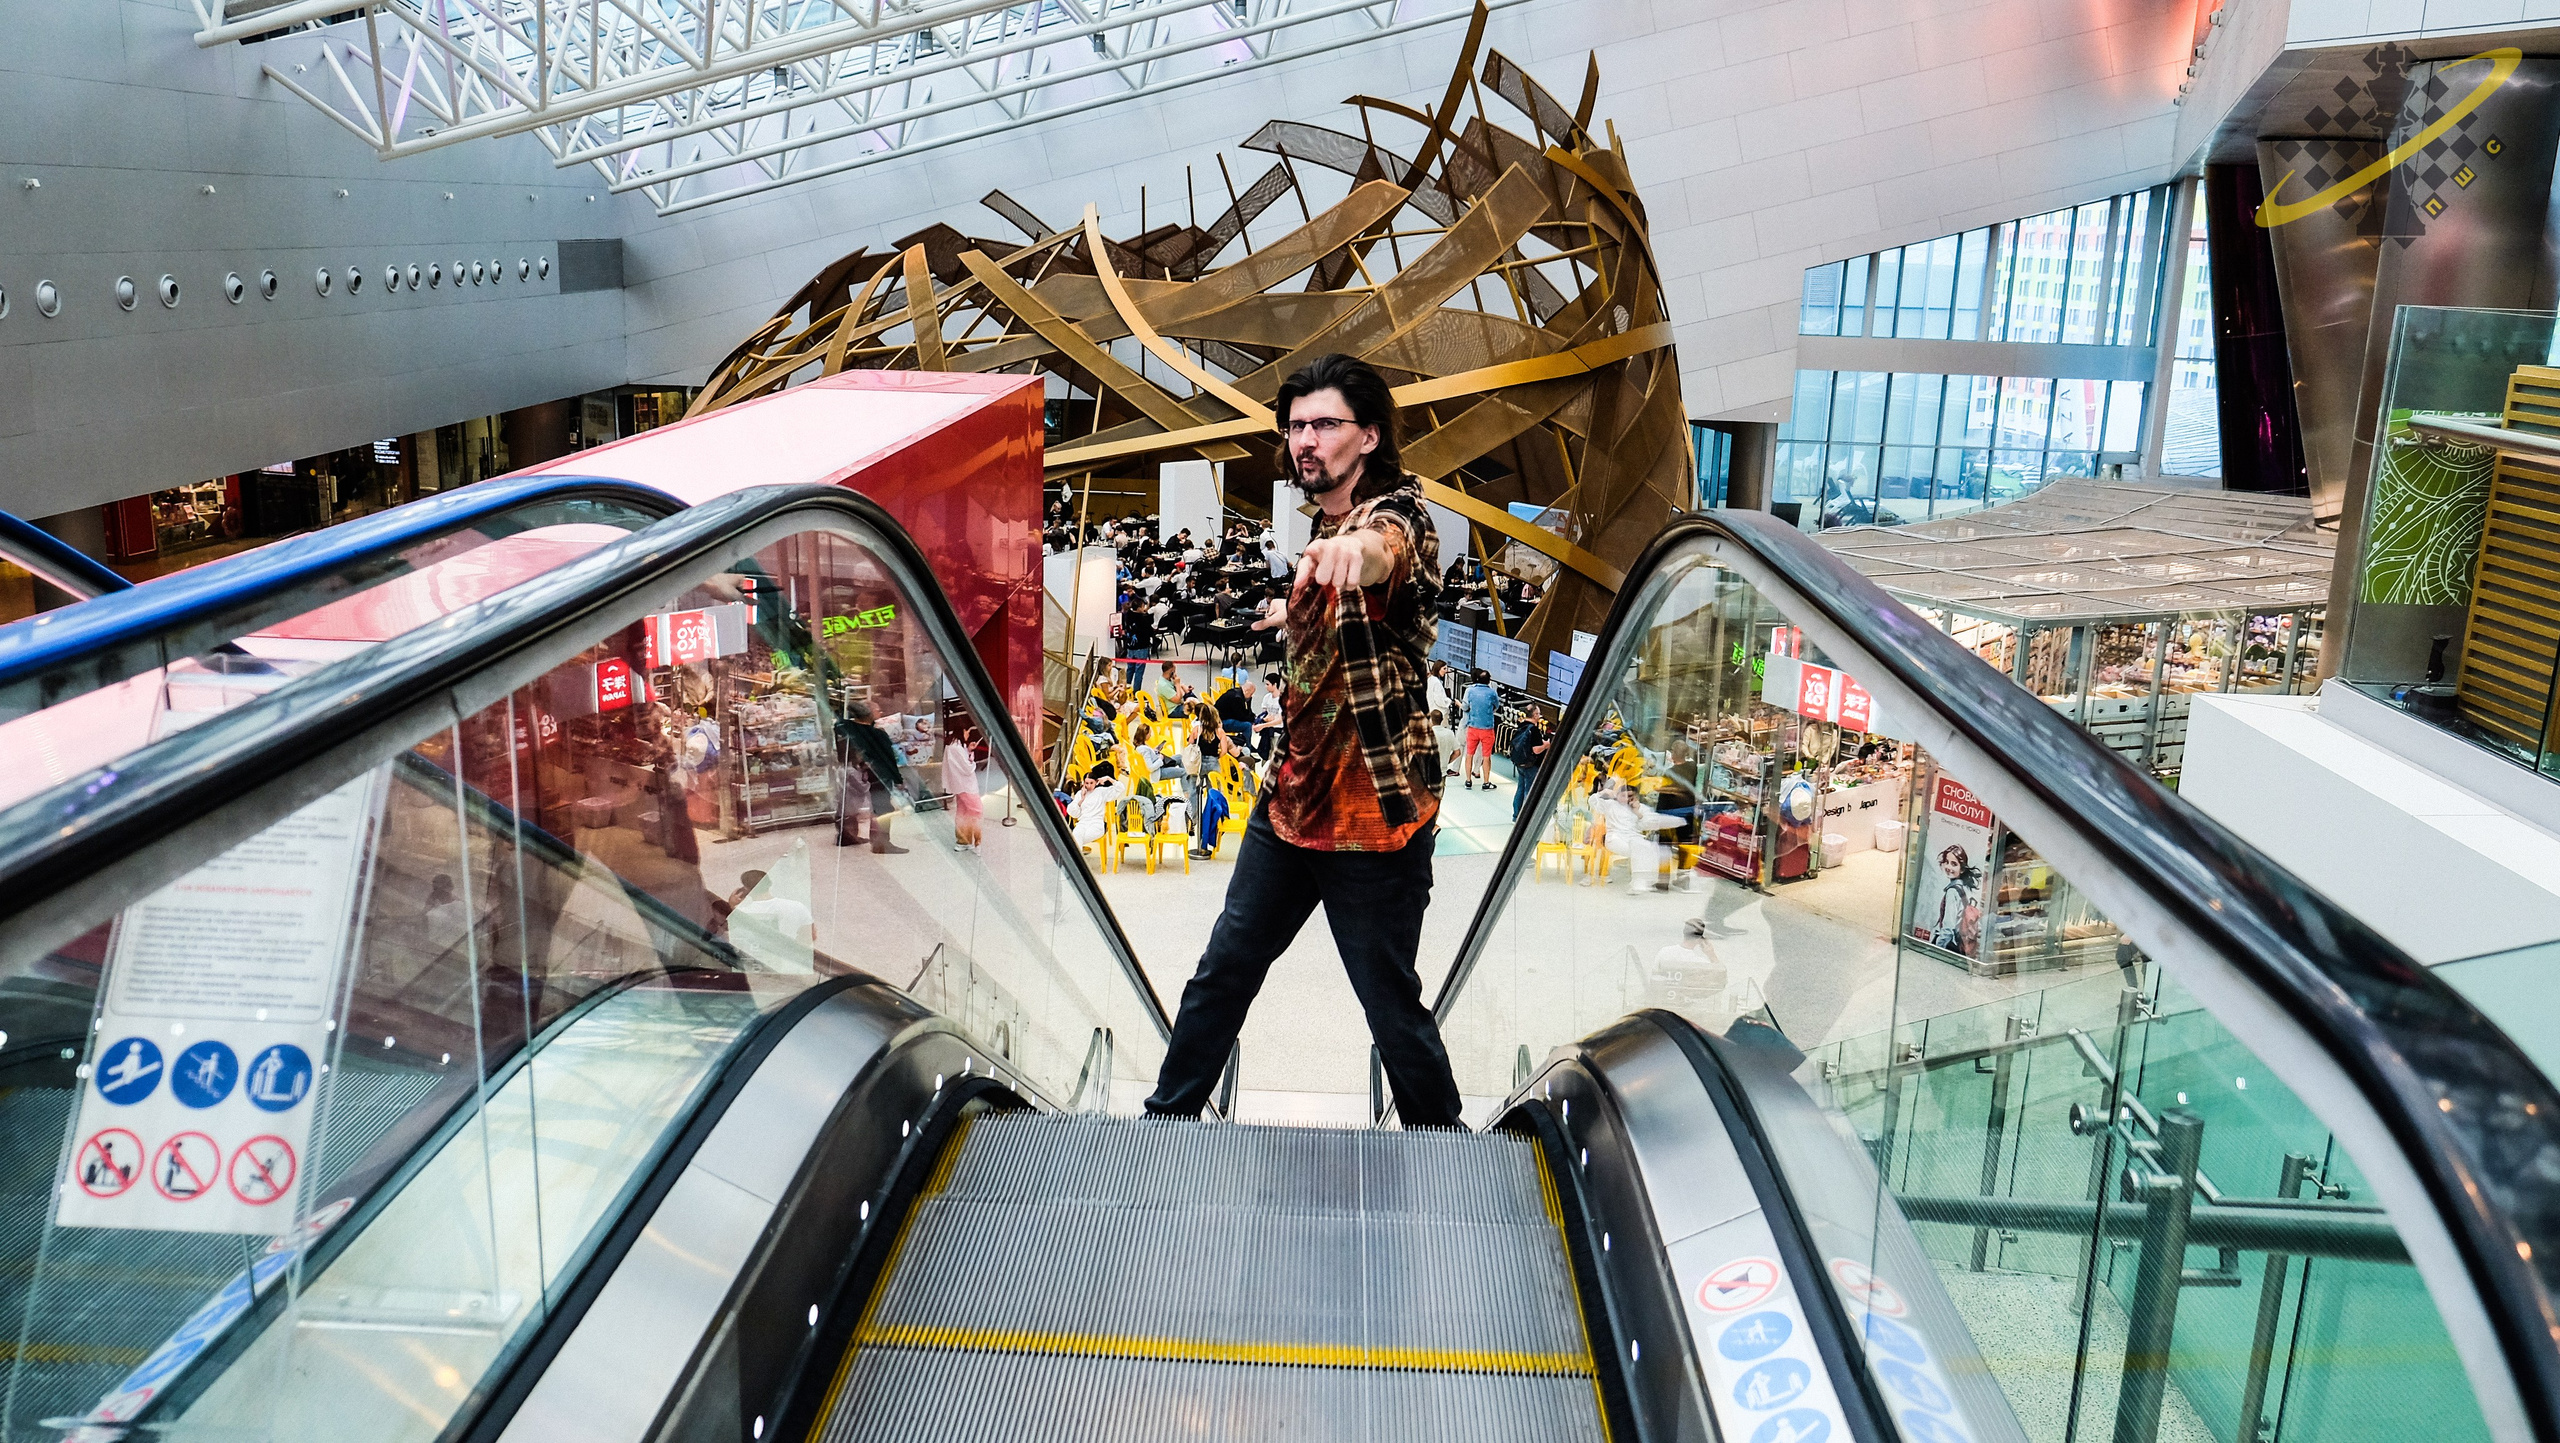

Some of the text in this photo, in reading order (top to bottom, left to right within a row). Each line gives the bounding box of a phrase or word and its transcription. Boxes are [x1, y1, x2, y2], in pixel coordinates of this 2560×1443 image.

[1943, 784, 1977, 804] СНОВА
[1860, 799, 1878, 810] Japan
[1942, 798, 1984, 820] ШКОЛУ!
